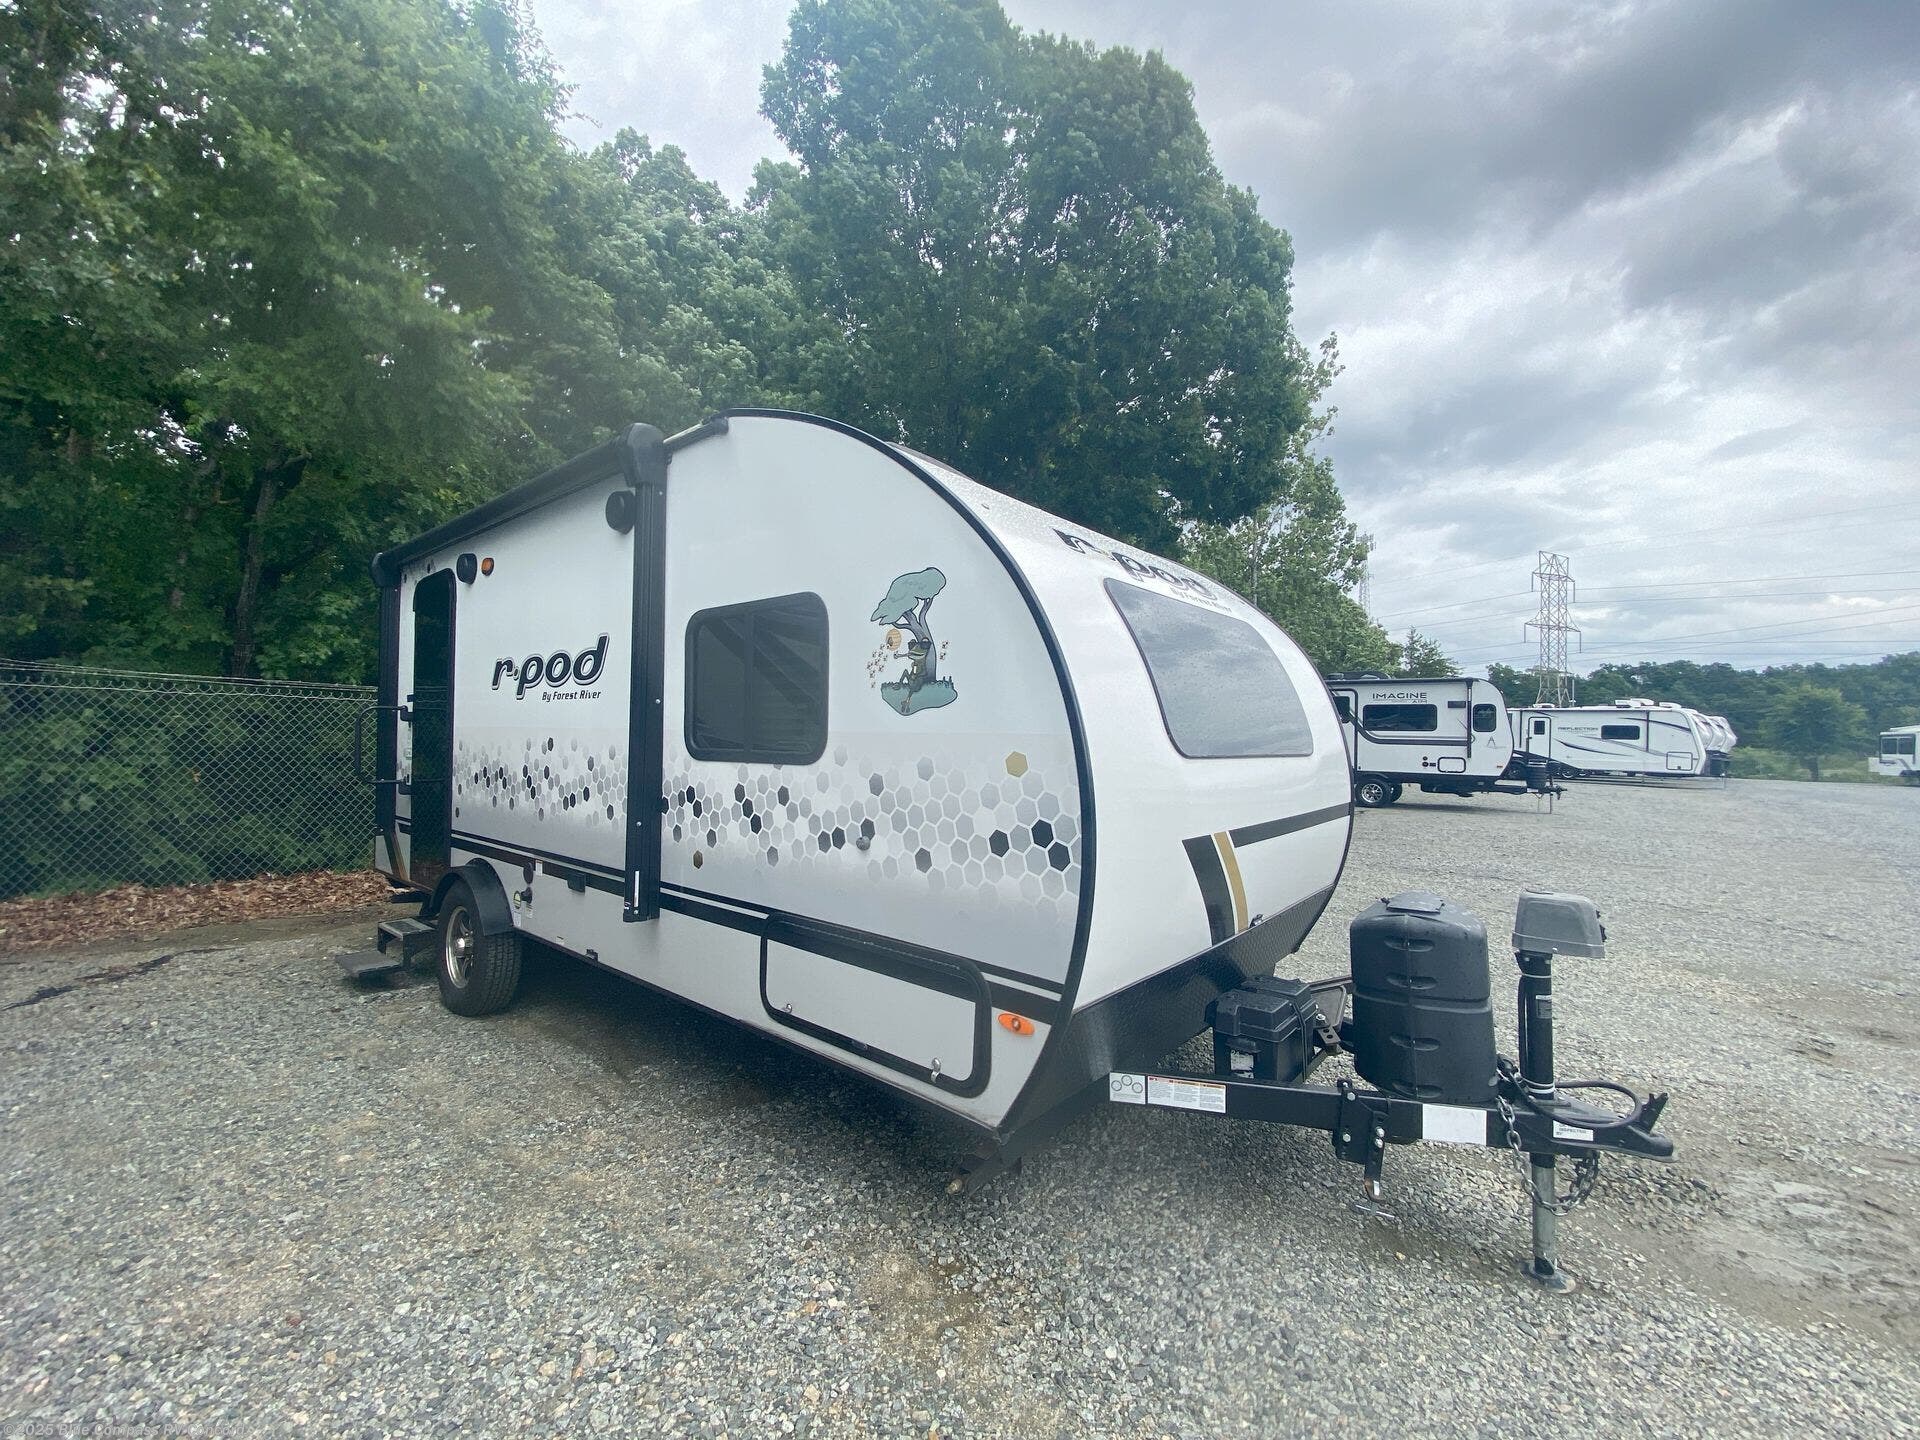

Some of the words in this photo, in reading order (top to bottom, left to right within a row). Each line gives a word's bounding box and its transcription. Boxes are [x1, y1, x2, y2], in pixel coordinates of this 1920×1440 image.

[542, 691, 552, 702] By
[553, 691, 578, 700] Forest
[579, 690, 602, 699] River
